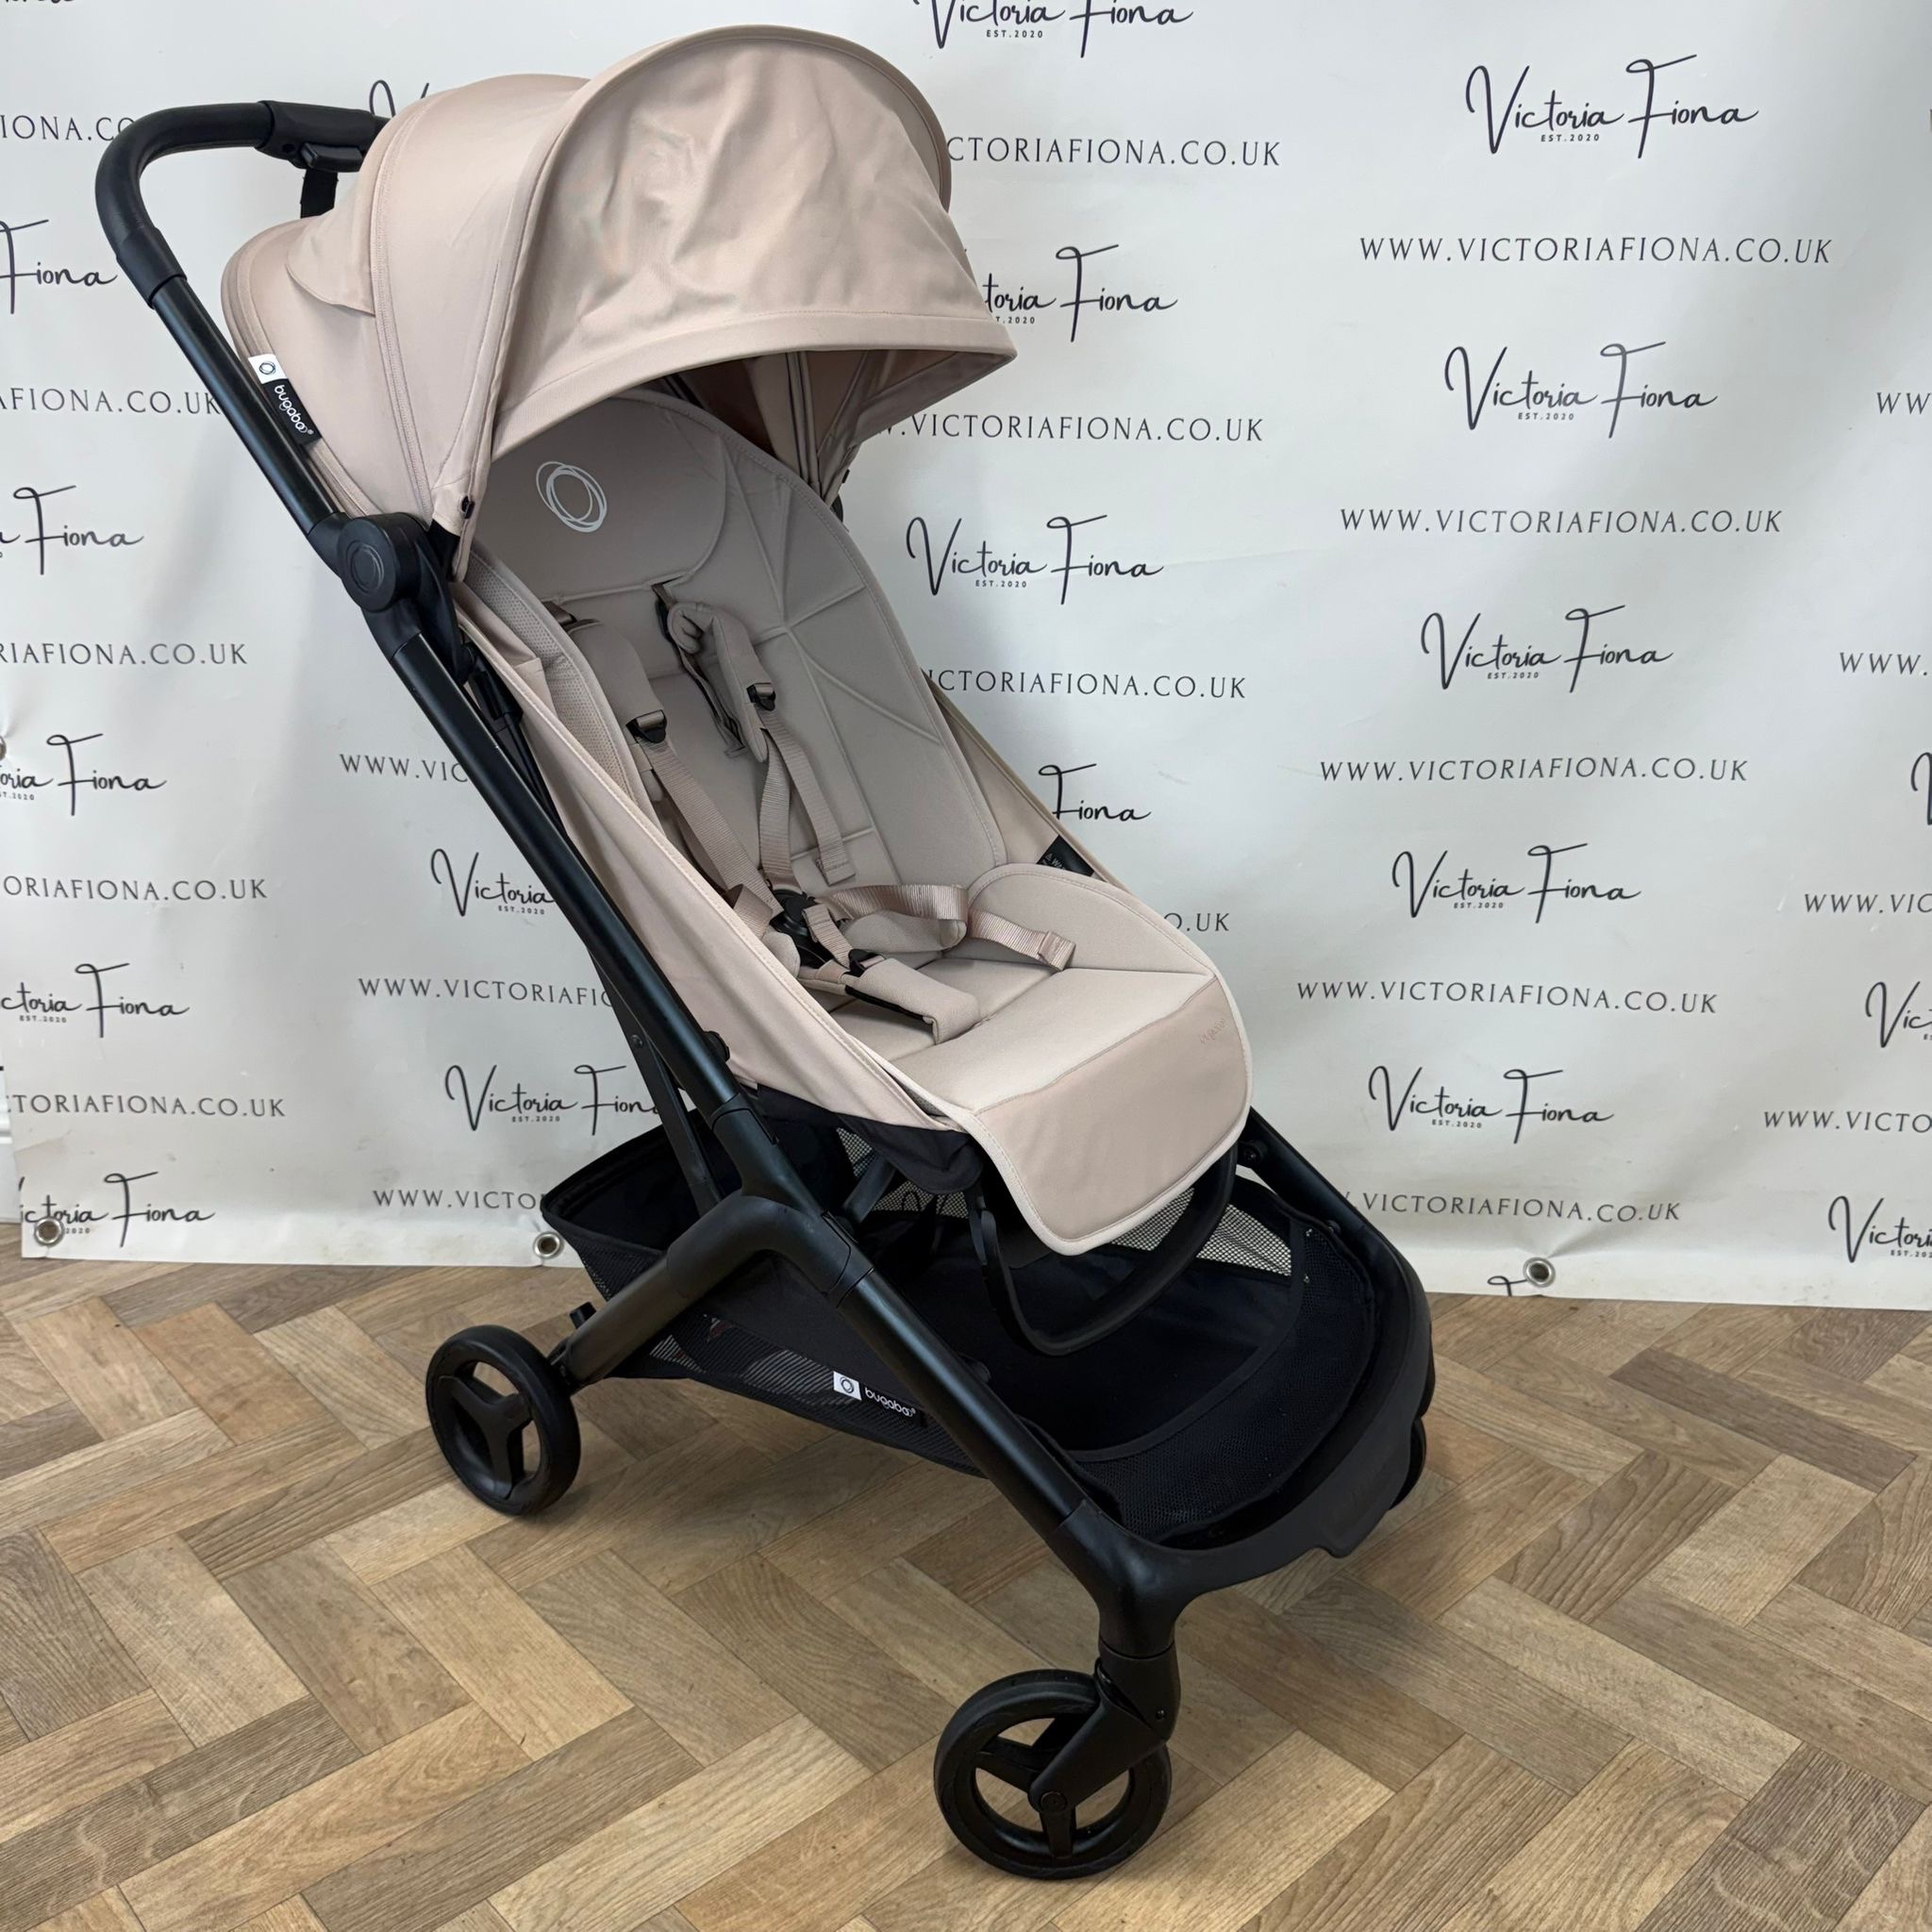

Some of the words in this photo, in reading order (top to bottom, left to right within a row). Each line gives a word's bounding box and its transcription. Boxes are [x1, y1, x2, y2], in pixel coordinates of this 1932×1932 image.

[986, 28, 1043, 39] EST.2020
[1465, 65, 1624, 155] Victoria
[1625, 54, 1759, 158] Fiona
[1540, 132, 1600, 143] EST.2020
[1360, 237, 1832, 263] WWW.VICTORIAFIONA.CO.UK
[981, 272, 1057, 312] toria
[1056, 244, 1178, 342] Fiona
[1444, 346, 1598, 430] Victoria
[1600, 341, 1718, 439] Fiona
[886, 414, 1263, 441] .VICTORIAFIONA.CO.UK
[1517, 411, 1574, 422] EST.2020
[12, 485, 144, 575] Fiona
[1341, 508, 1782, 533] WWW.VICTORIAFIONA.CO.UK
[906, 517, 1047, 596] Victoria
[1046, 514, 1164, 606] Fiona
[974, 578, 1027, 589] EST.2020
[1421, 612, 1562, 690] Victoria
[1563, 605, 1674, 693] Fiona
[1487, 671, 1540, 680] EST.2020
[46, 733, 167, 816] Fiona
[1321, 757, 1748, 781] WWW.VICTORIAFIONA.CO.UK
[430, 848, 556, 917] Victoria
[1391, 850, 1525, 918] Victoria
[1527, 842, 1641, 924] Fiona
[497, 905, 545, 916] EST.2020
[1453, 901, 1505, 909] EST.2020
[75, 963, 190, 1039] Fiona
[1297, 981, 1717, 1013] WWW.VICTORIAFIONA.CO.UK
[18, 1014, 67, 1024] EST.2020
[6, 1094, 285, 1117] TORIAFIONA.CO.UK
[444, 1065, 578, 1131] Victoria
[1368, 1065, 1503, 1131] Victoria
[1503, 1069, 1614, 1144] Fiona
[510, 1115, 561, 1124] EST.2020
[1431, 1118, 1483, 1129] EST.2020
[18, 1176, 109, 1224] ictoria
[103, 1172, 215, 1248] Fiona
[373, 1190, 545, 1209] WWW.VICTO
[1346, 1191, 1680, 1223] VICTORIAFIONA.CO.UK
[1828, 1195, 1932, 1263] Victori
